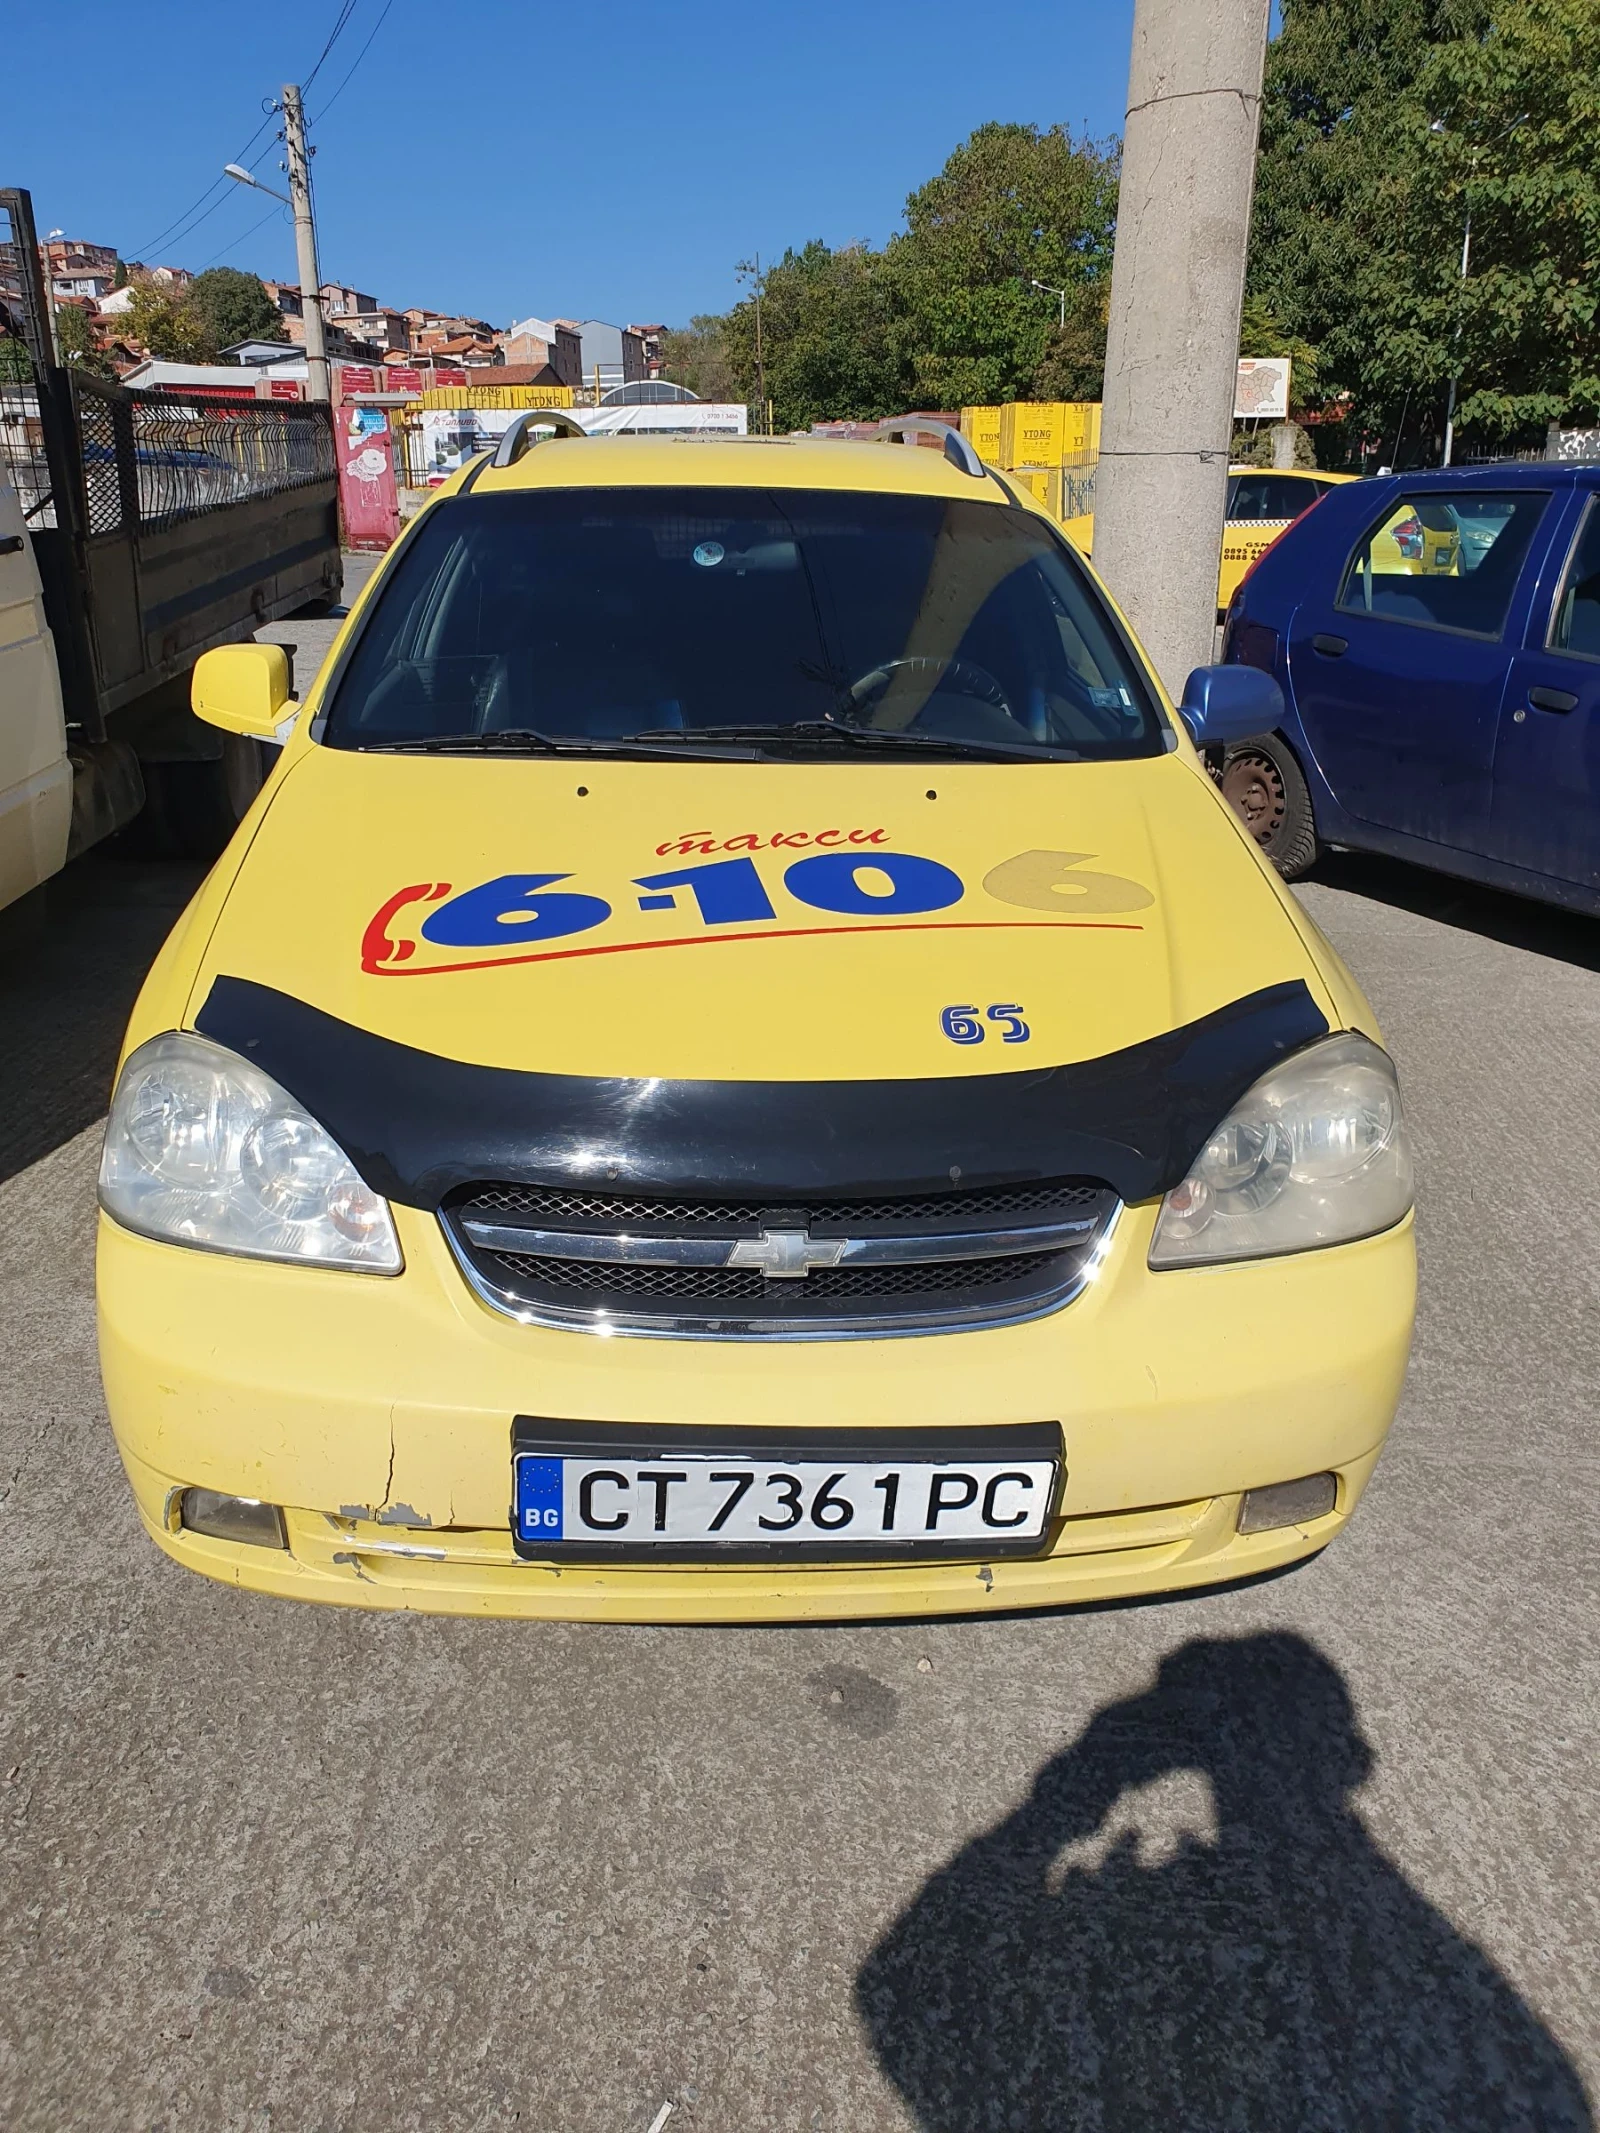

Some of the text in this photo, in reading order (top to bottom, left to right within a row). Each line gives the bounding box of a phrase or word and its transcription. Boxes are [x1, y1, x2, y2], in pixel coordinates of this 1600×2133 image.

[467, 386, 501, 396] YTONG
[526, 396, 561, 407] YTONG
[1023, 429, 1052, 438] YTONG
[656, 826, 891, 857] такси
[938, 1003, 1032, 1045] 65
[524, 1507, 560, 1528] BG
